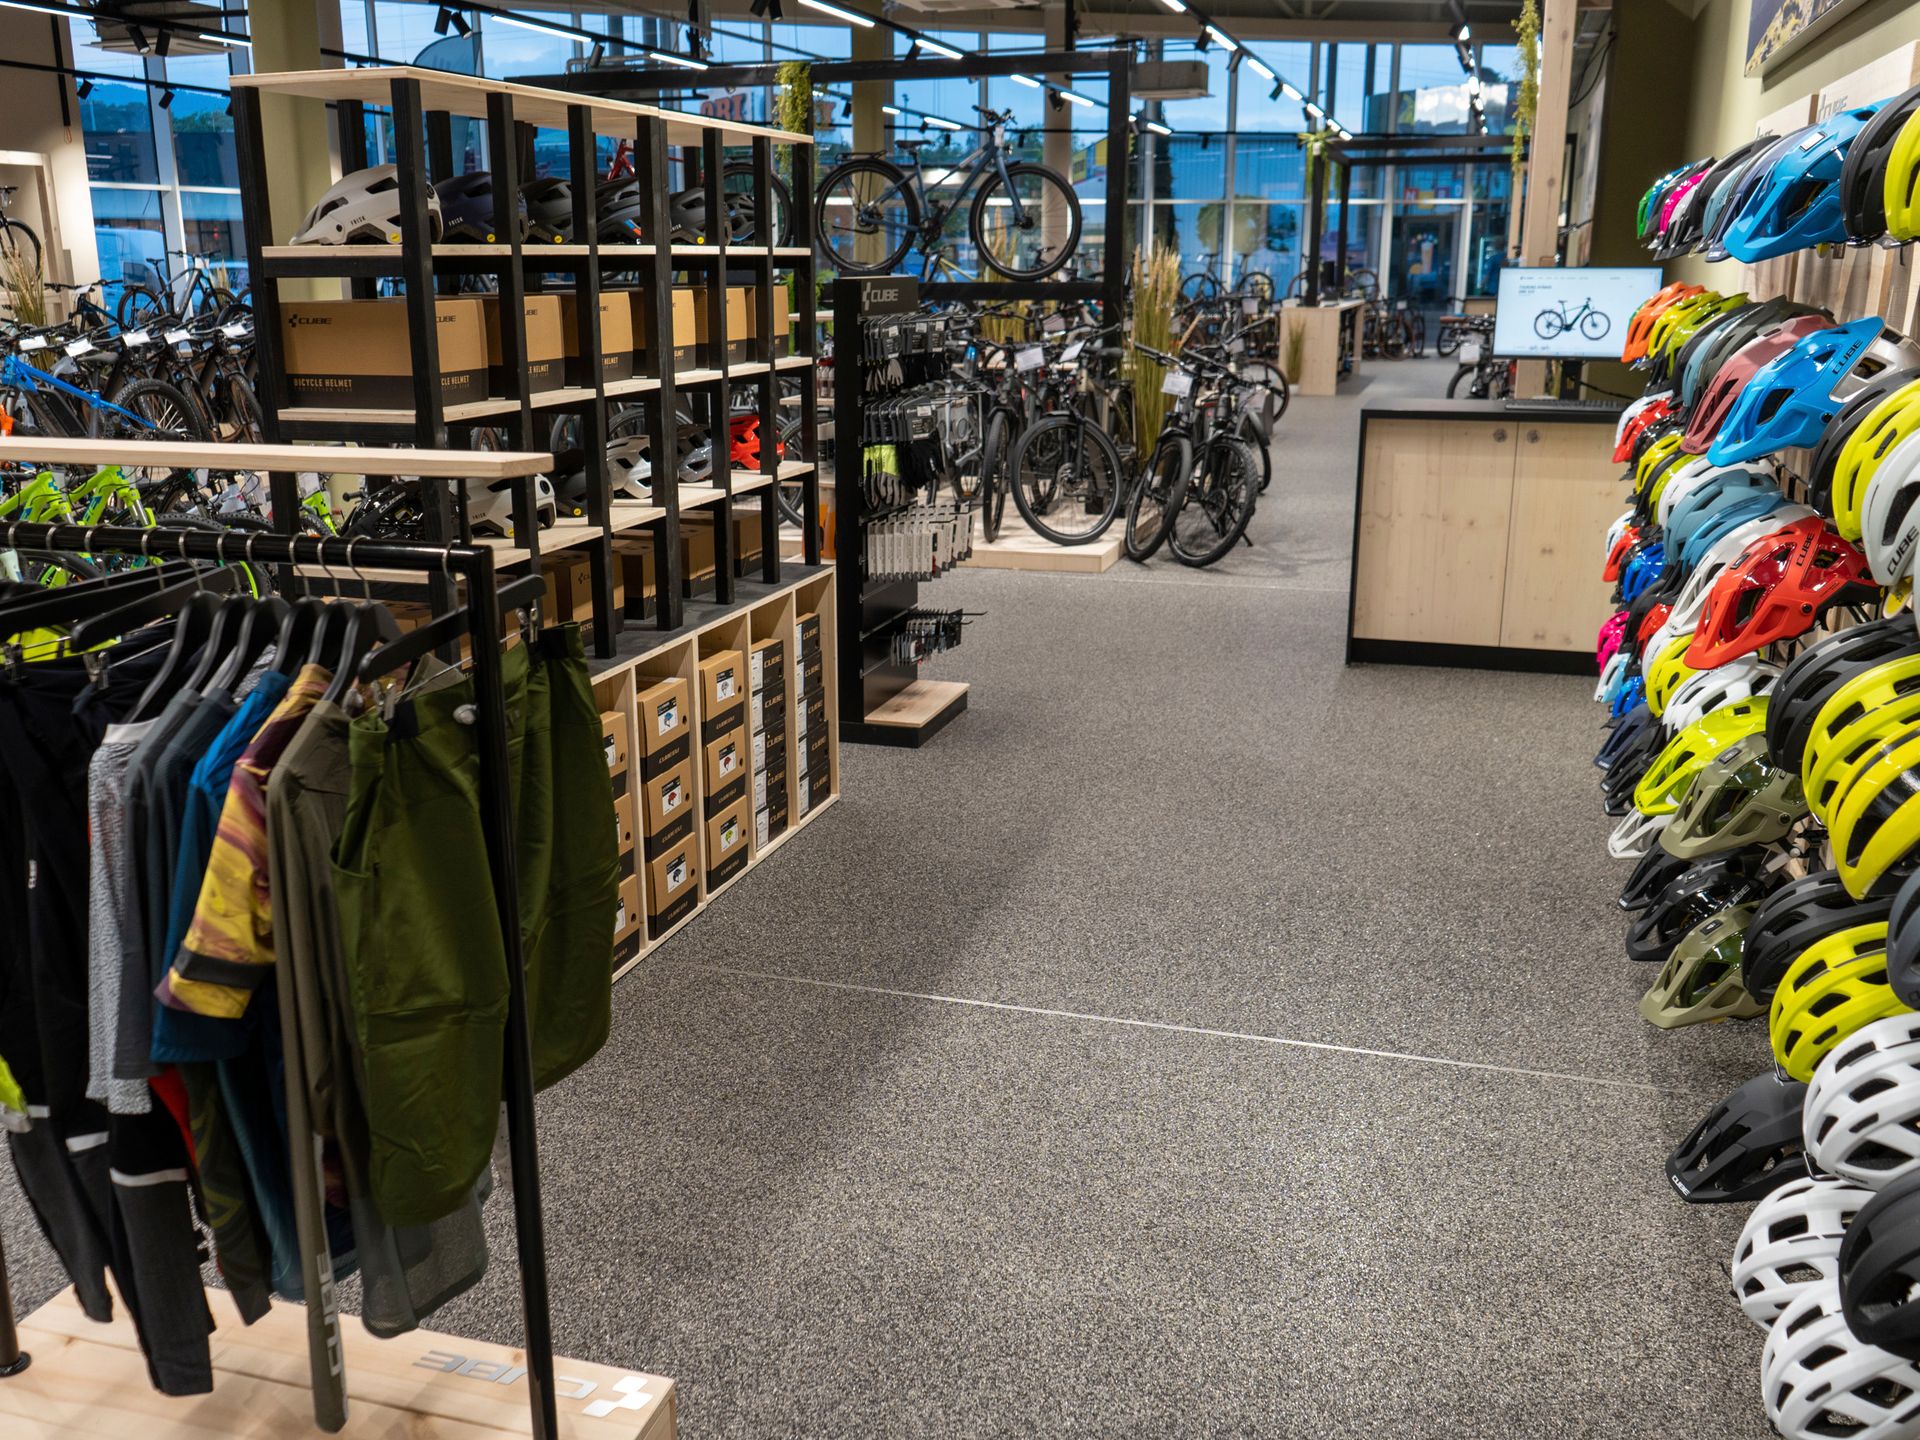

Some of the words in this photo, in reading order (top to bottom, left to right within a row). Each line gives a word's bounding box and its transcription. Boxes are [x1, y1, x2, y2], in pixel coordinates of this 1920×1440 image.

[871, 288, 899, 303] CUBE
[298, 317, 332, 325] CUBE
[1832, 339, 1863, 375] CUBE
[294, 378, 323, 388] BICYCLE
[325, 379, 352, 388] HELMET
[451, 375, 469, 385] HELMET
[1795, 530, 1816, 568] CUBE
[1887, 525, 1920, 577] CUBE
[764, 653, 783, 669] CUBE
[764, 693, 784, 708] CUBE
[766, 733, 784, 749] CUBE
[767, 771, 785, 786] CUBE
[1671, 1174, 1691, 1196] CUBE
[316, 1252, 342, 1378] CUBE
